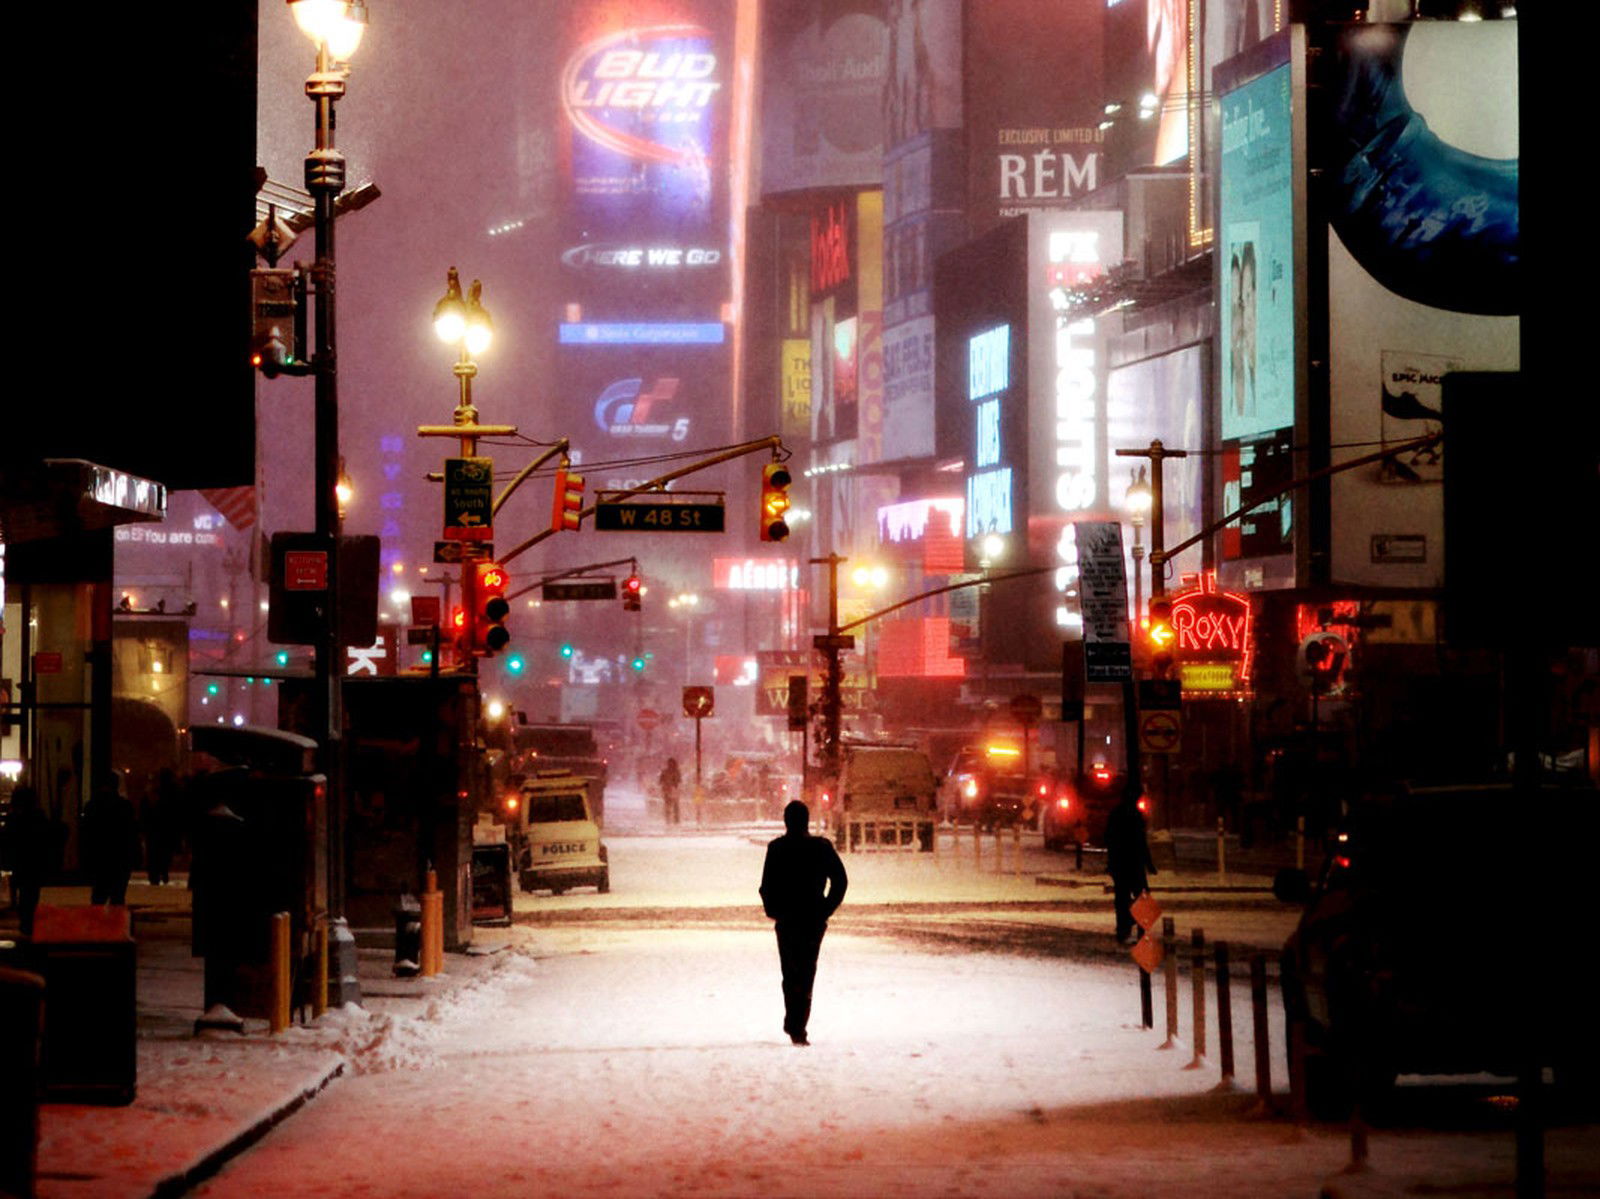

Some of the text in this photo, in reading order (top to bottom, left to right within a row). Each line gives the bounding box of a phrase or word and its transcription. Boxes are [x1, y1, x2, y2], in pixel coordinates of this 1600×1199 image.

[594, 50, 717, 79] BUD
[571, 81, 721, 107] LIGHT
[999, 128, 1050, 144] EXCLUSIVE
[1053, 128, 1093, 144] LIMITED
[583, 247, 721, 266] HERE WE GO
[1391, 373, 1416, 383] EPIC
[671, 418, 689, 442] 5
[619, 509, 701, 526] W 48 St
[145, 530, 166, 544] You
[169, 533, 192, 544] are
[1172, 604, 1245, 650] ROXY
[542, 843, 586, 856] POLICE
